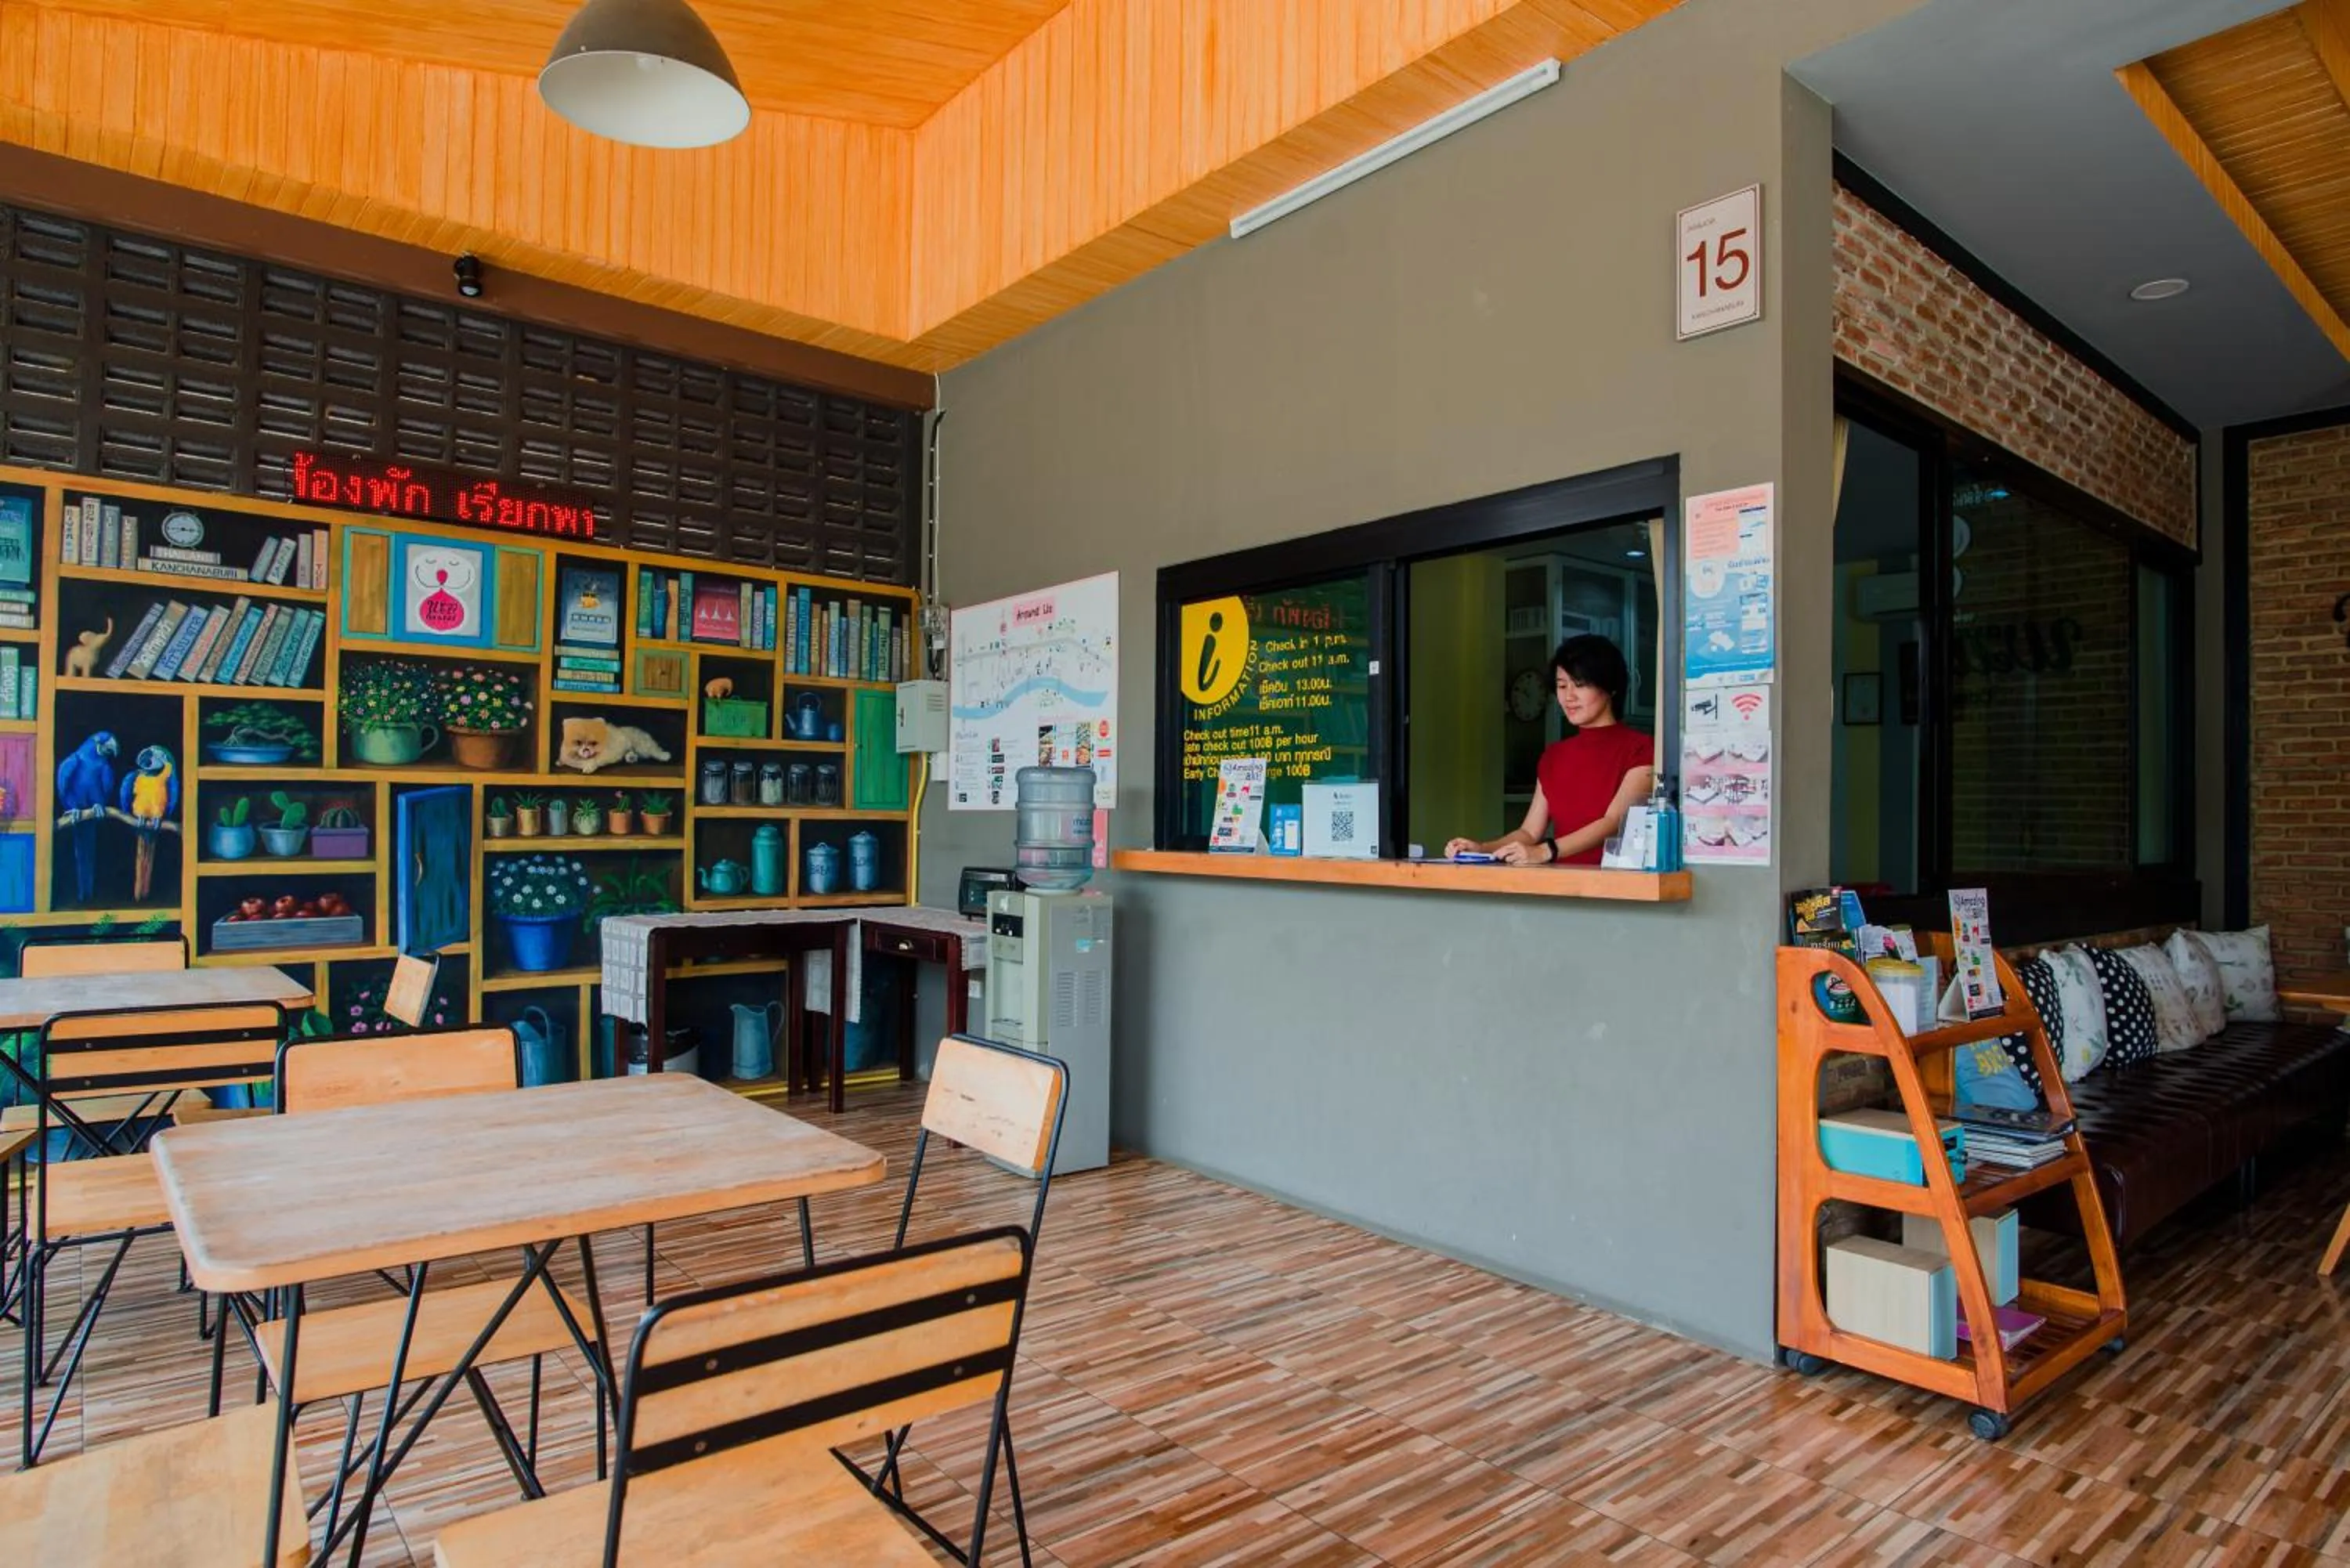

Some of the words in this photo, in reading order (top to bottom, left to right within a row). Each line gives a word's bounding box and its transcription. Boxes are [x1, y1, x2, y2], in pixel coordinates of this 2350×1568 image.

[1686, 228, 1750, 298] 15
[151, 562, 237, 577] KANCHANABURI
[1265, 639, 1296, 652] Check
[1314, 635, 1318, 645] 1
[1259, 659, 1289, 672] Check
[1292, 656, 1308, 667] out
[1312, 654, 1323, 666] 11
[1328, 653, 1350, 665] a.m.
[1194, 640, 1258, 721] INFORMATION
[1184, 729, 1209, 741] Check
[1212, 728, 1227, 739] out
[1264, 725, 1284, 735] a.m.
[1202, 739, 1229, 752] check
[1231, 739, 1246, 750] out
[1276, 736, 1292, 750] per
[1295, 732, 1318, 745] hour
[1184, 768, 1204, 781] Early
